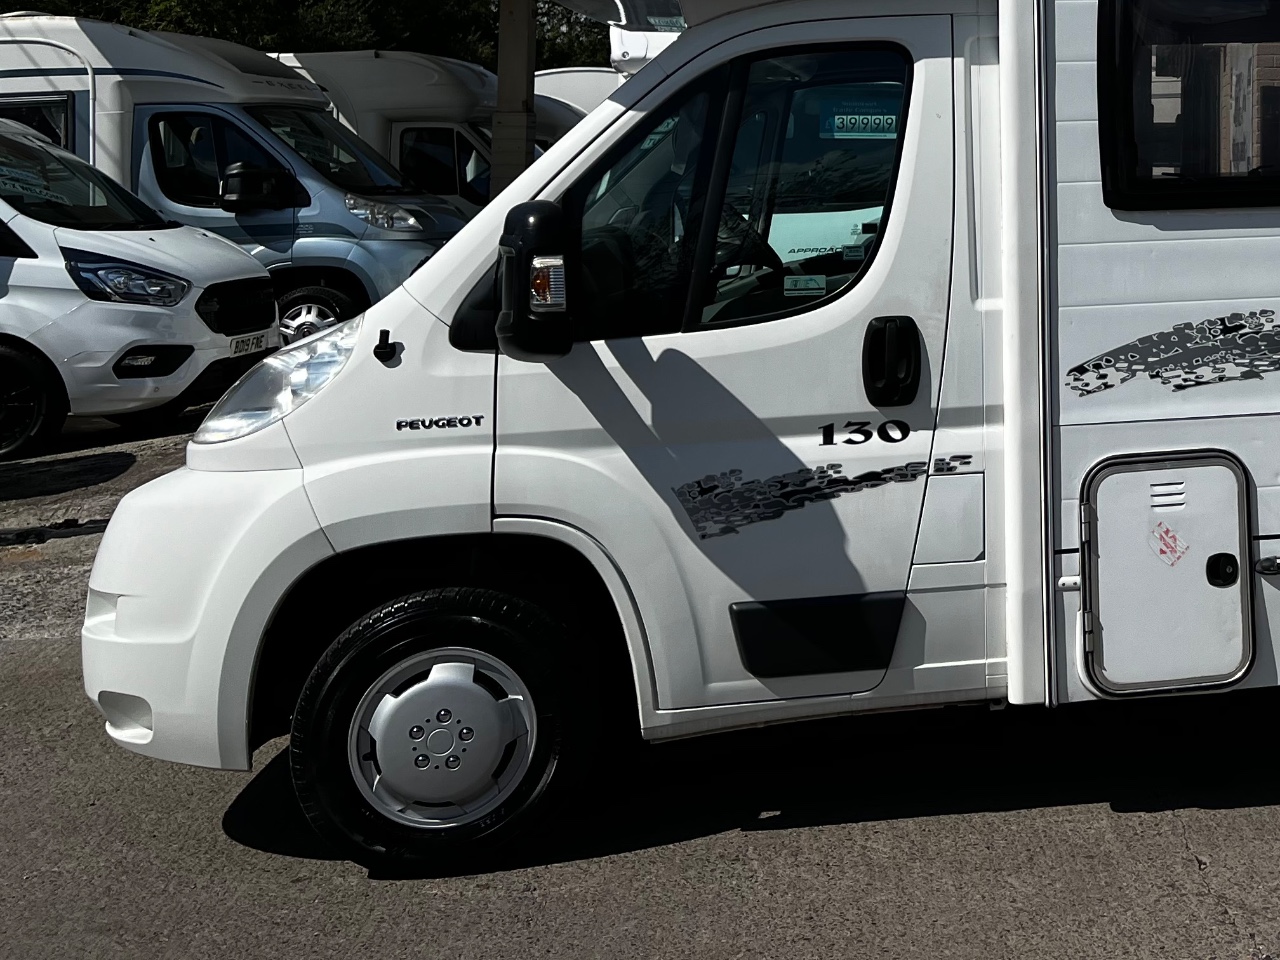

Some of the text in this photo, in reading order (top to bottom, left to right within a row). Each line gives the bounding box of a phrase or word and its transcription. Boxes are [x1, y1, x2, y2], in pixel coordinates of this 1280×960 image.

[836, 117, 895, 130] 39999
[396, 415, 484, 431] PEUGEOT
[818, 419, 911, 446] 130
